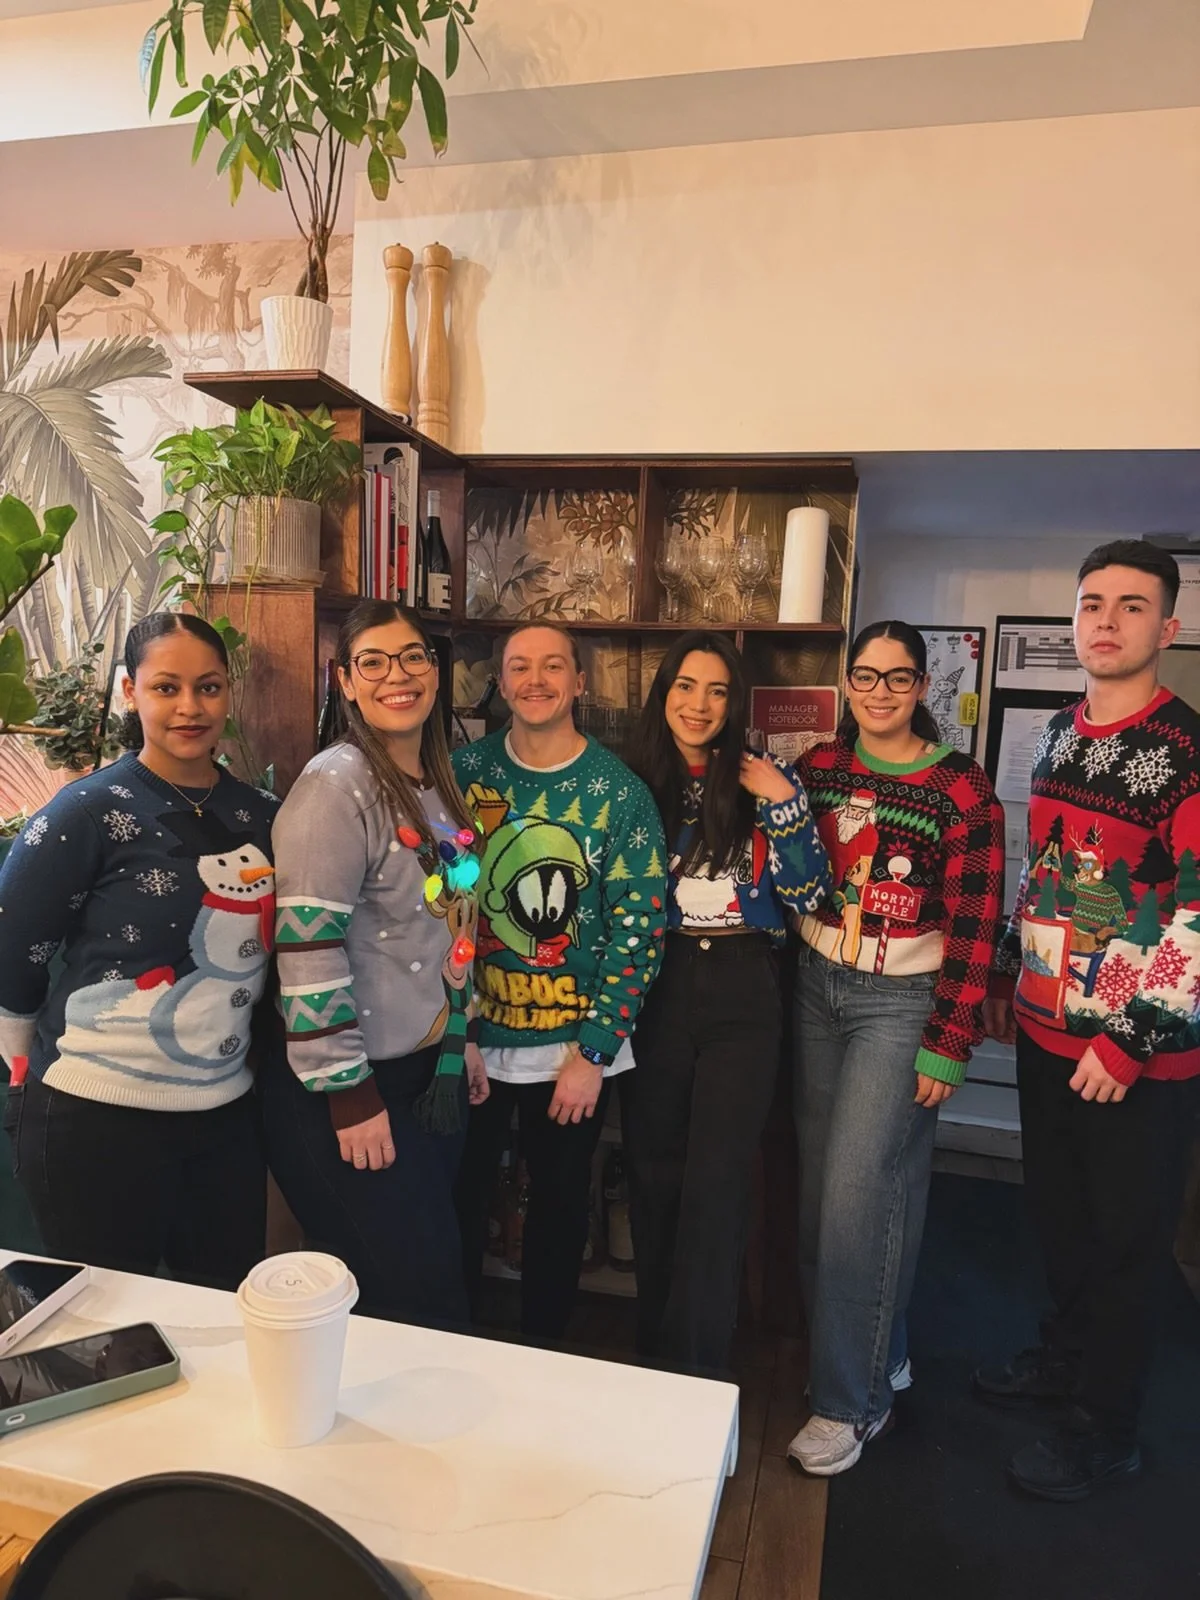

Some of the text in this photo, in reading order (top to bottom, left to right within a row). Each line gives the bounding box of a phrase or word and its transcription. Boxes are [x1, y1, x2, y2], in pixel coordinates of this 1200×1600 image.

[768, 704, 819, 713] MANAGER
[768, 715, 819, 725] NOTEBOOK
[870, 887, 915, 908] NORTH
[872, 901, 909, 918] POLE
